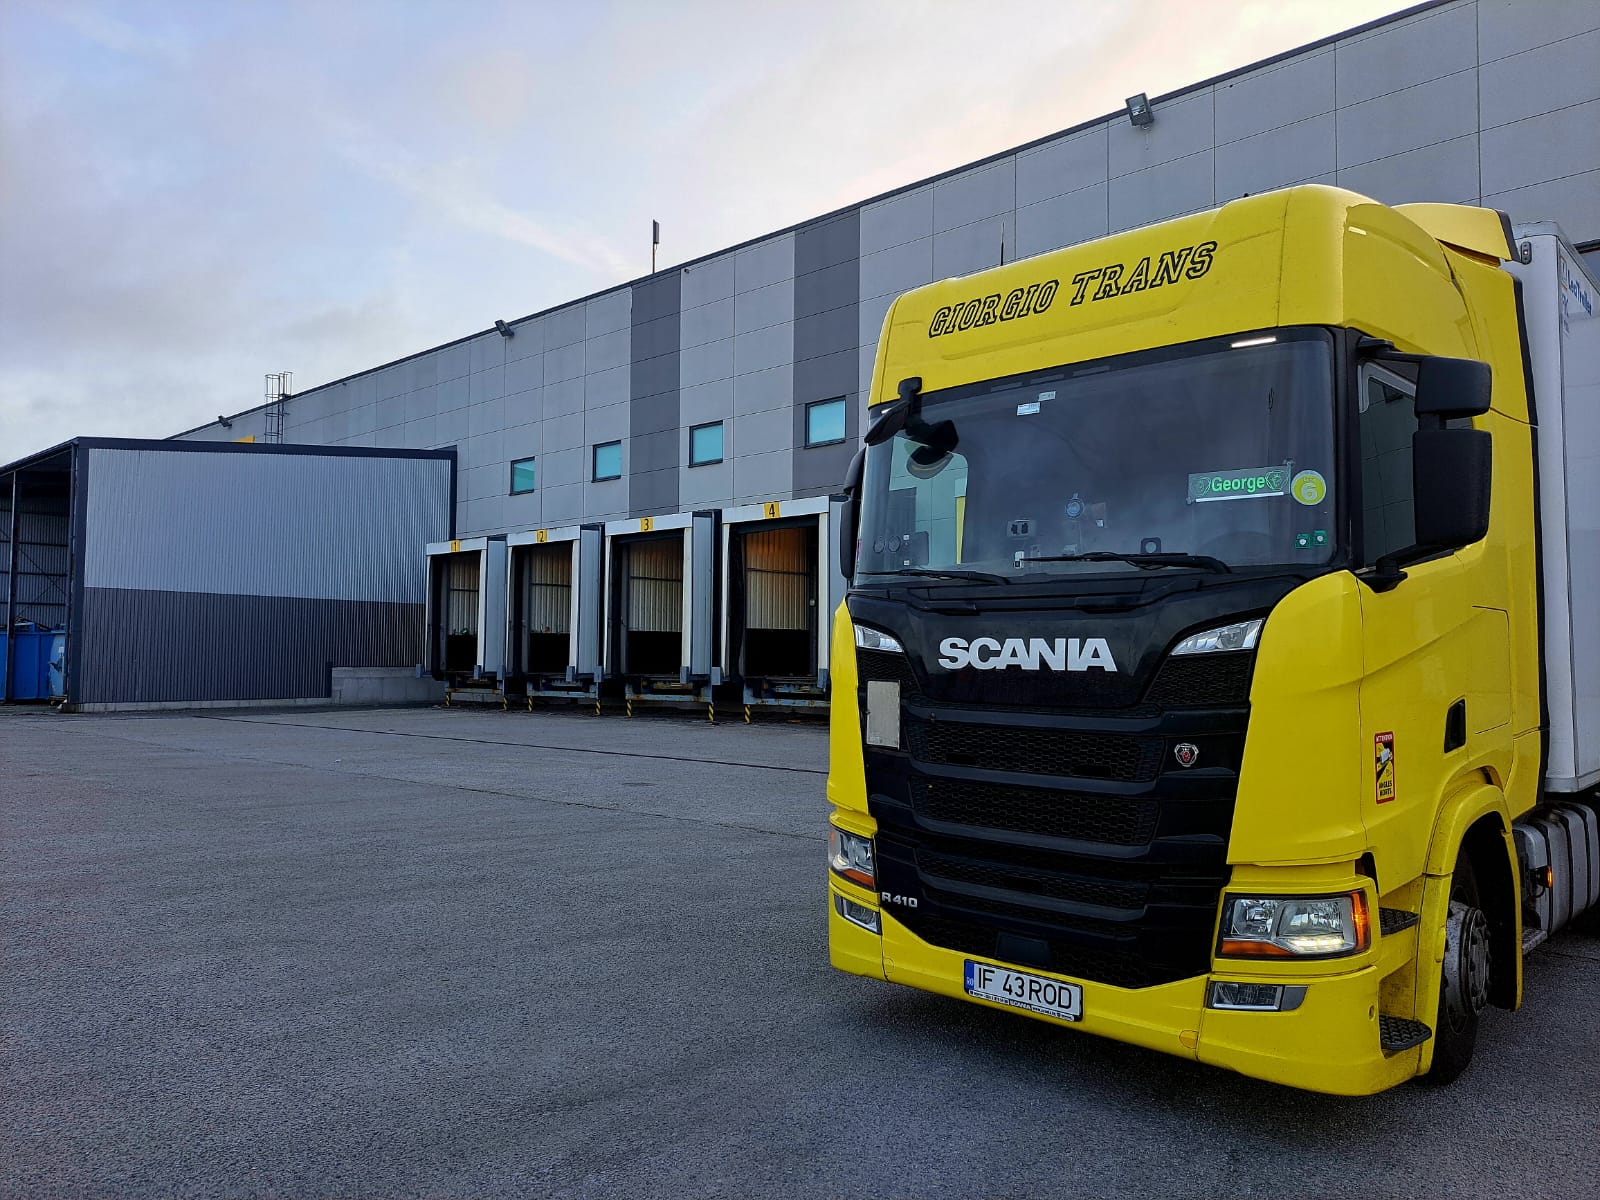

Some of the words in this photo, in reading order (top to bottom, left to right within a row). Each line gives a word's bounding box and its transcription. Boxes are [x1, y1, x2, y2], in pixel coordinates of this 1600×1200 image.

[928, 279, 1060, 339] GIORGIO
[1070, 240, 1218, 307] TRANS
[1211, 476, 1266, 493] George
[1301, 482, 1318, 501] 6
[768, 503, 776, 518] 4
[643, 518, 650, 531] 3
[539, 530, 545, 543] 2
[938, 637, 1118, 672] SCANIA
[978, 967, 995, 990] IF
